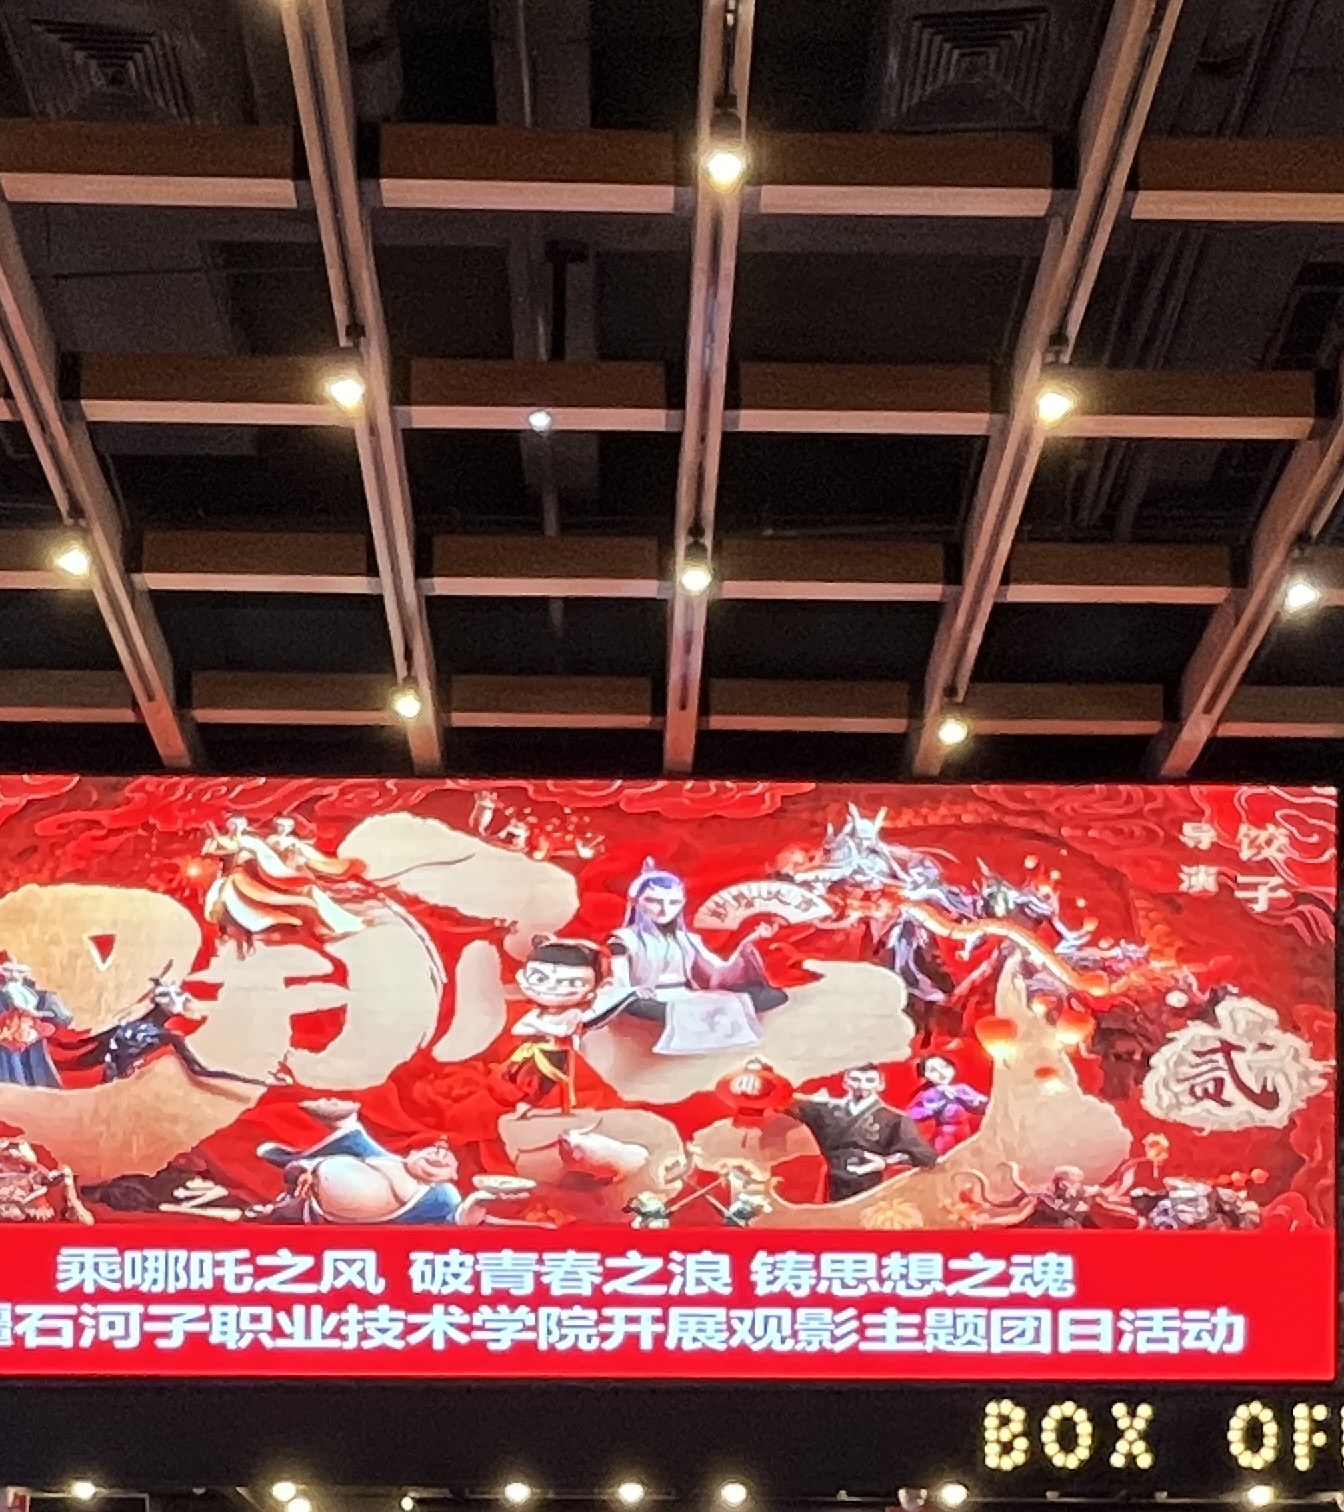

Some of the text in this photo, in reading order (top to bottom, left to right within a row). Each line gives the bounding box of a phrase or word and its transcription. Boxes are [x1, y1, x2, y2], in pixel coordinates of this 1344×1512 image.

[1179, 822, 1219, 893] 导演
[1235, 822, 1291, 913] 饺子
[56, 1247, 1075, 1298] 乘哪吒之风 破青春之浪 铸思想之魂
[982, 1398, 1154, 1472] BOX
